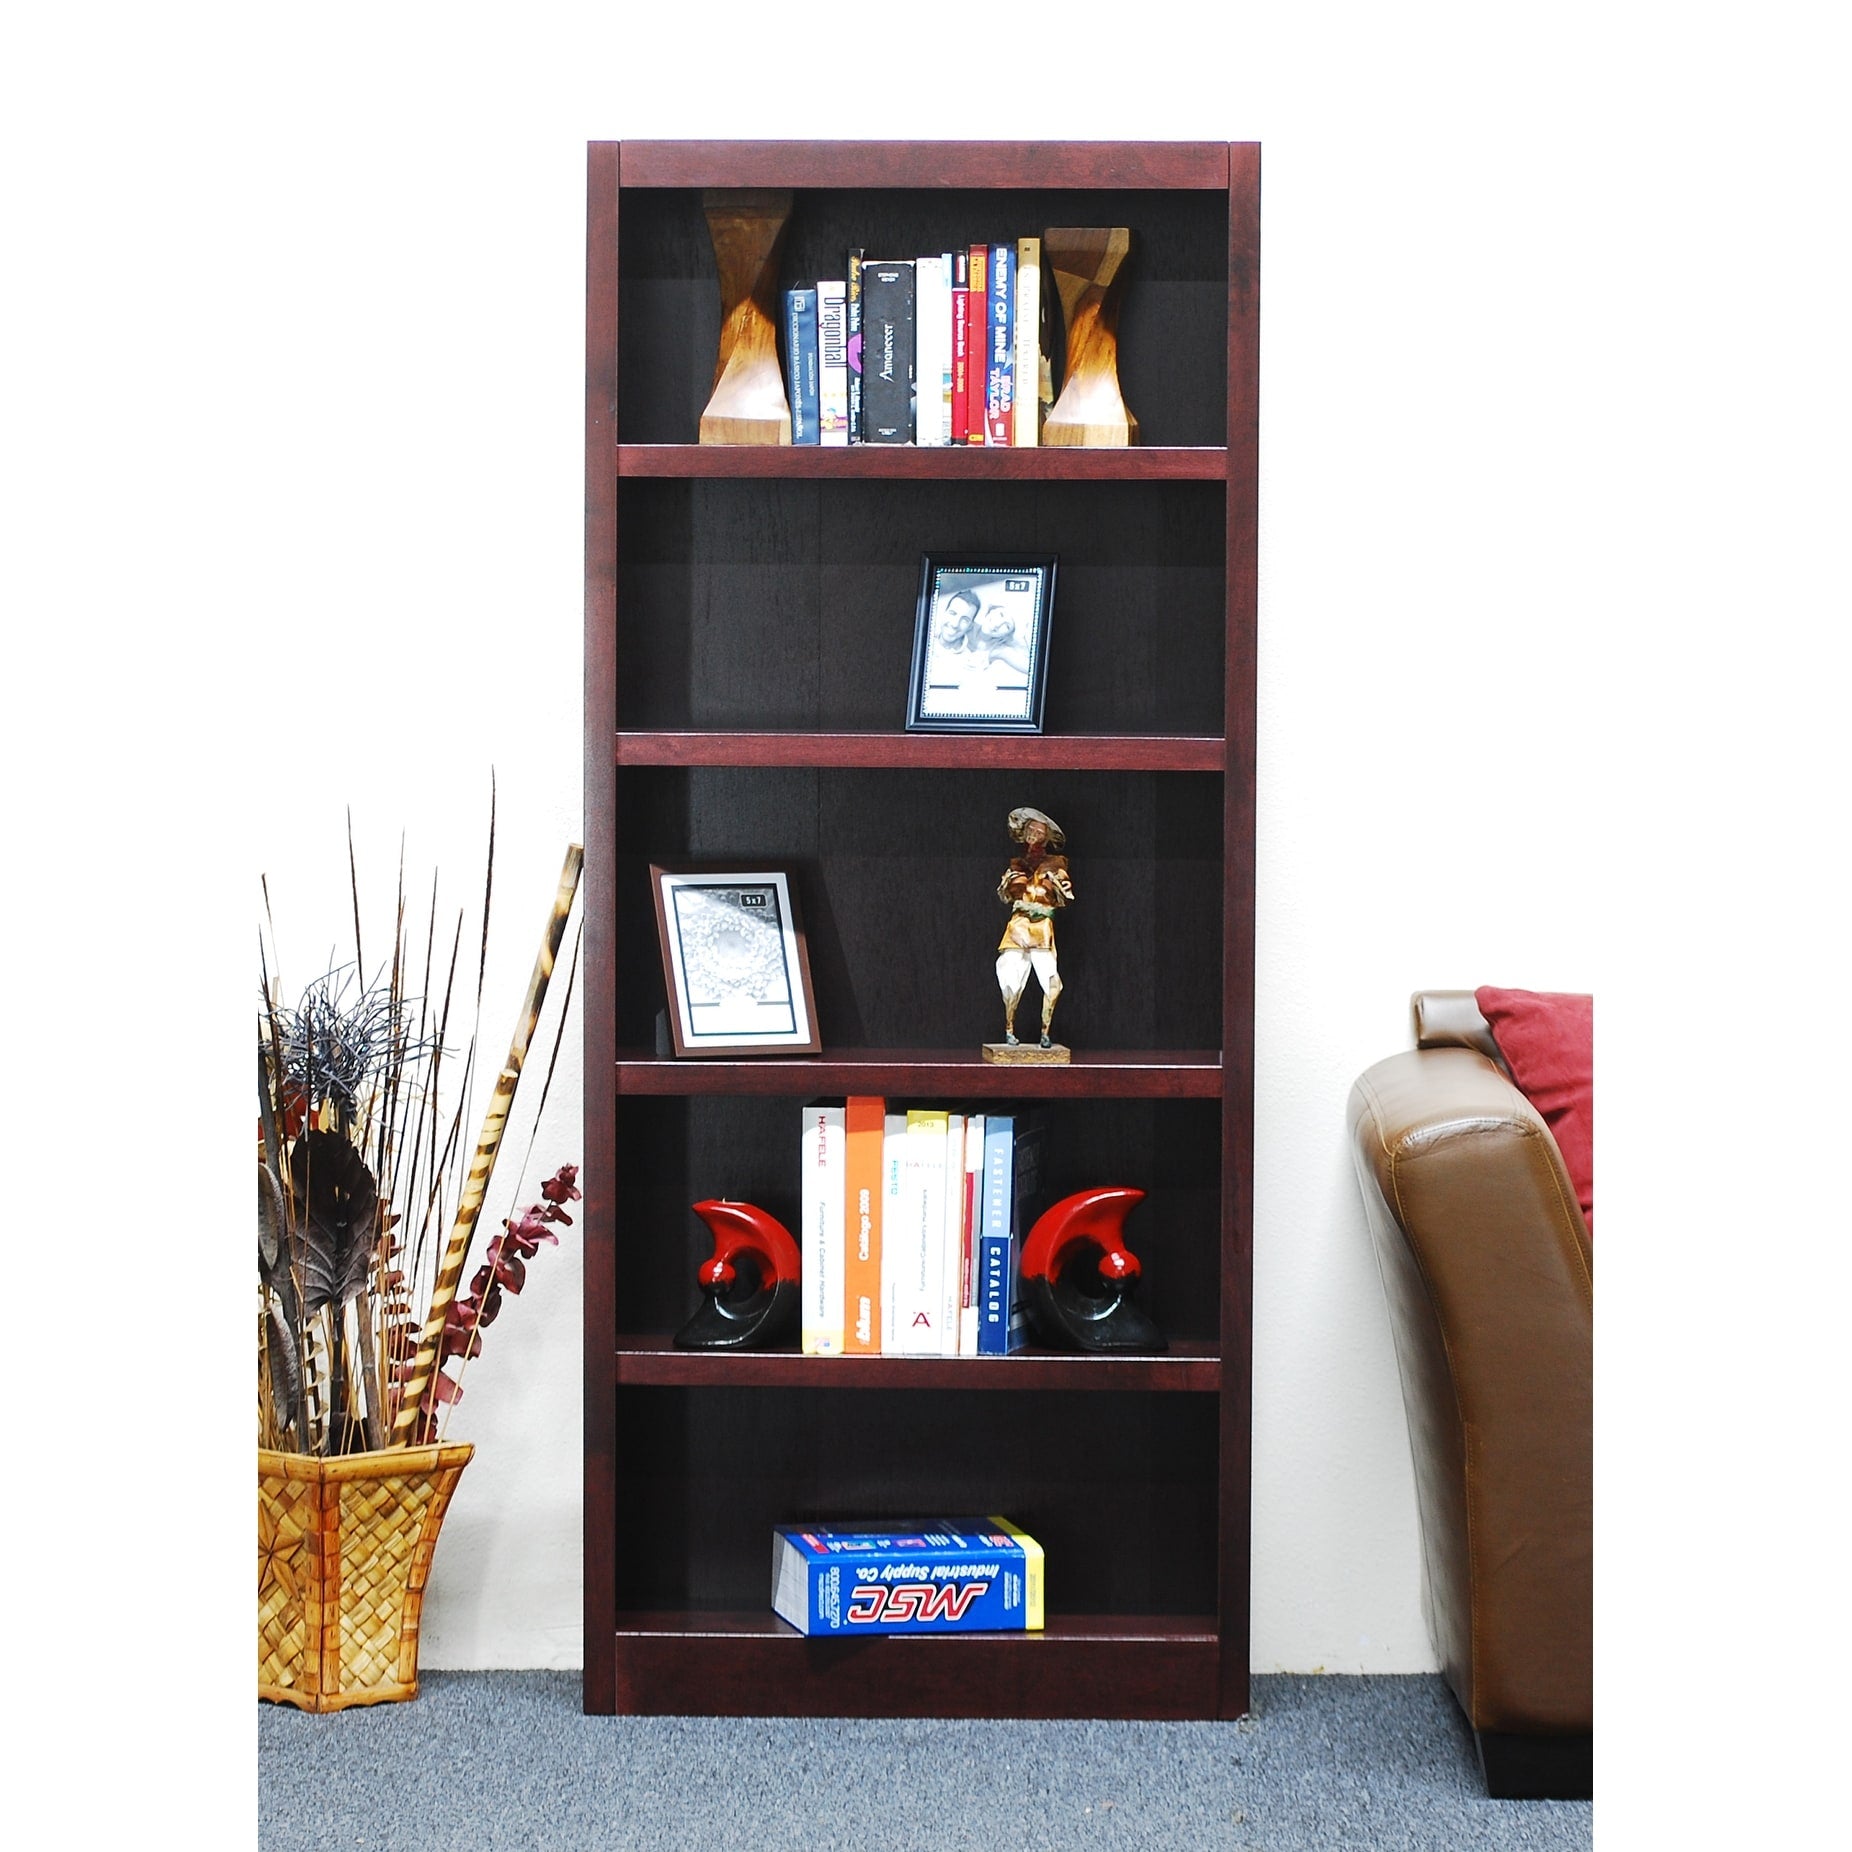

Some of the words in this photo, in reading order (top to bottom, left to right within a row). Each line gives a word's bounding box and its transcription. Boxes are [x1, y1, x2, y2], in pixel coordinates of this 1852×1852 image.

[994, 247, 1007, 298] ENEMY
[995, 301, 1007, 324] OF
[819, 297, 847, 368] Dragonball
[994, 325, 1007, 364] MINE
[878, 324, 894, 383] Amanecer
[989, 368, 1001, 419] TAYLOR
[1000, 374, 1013, 412] BRAD
[745, 896, 761, 905] 5x7
[991, 1148, 1004, 1228] FASTENER
[818, 1201, 827, 1237] Furniture
[988, 1246, 1002, 1323] CATALOG
[856, 1566, 879, 1583] Co.
[880, 1563, 930, 1583] Supply
[930, 1564, 1000, 1582] Industrial
[847, 1583, 989, 1624] MSC
